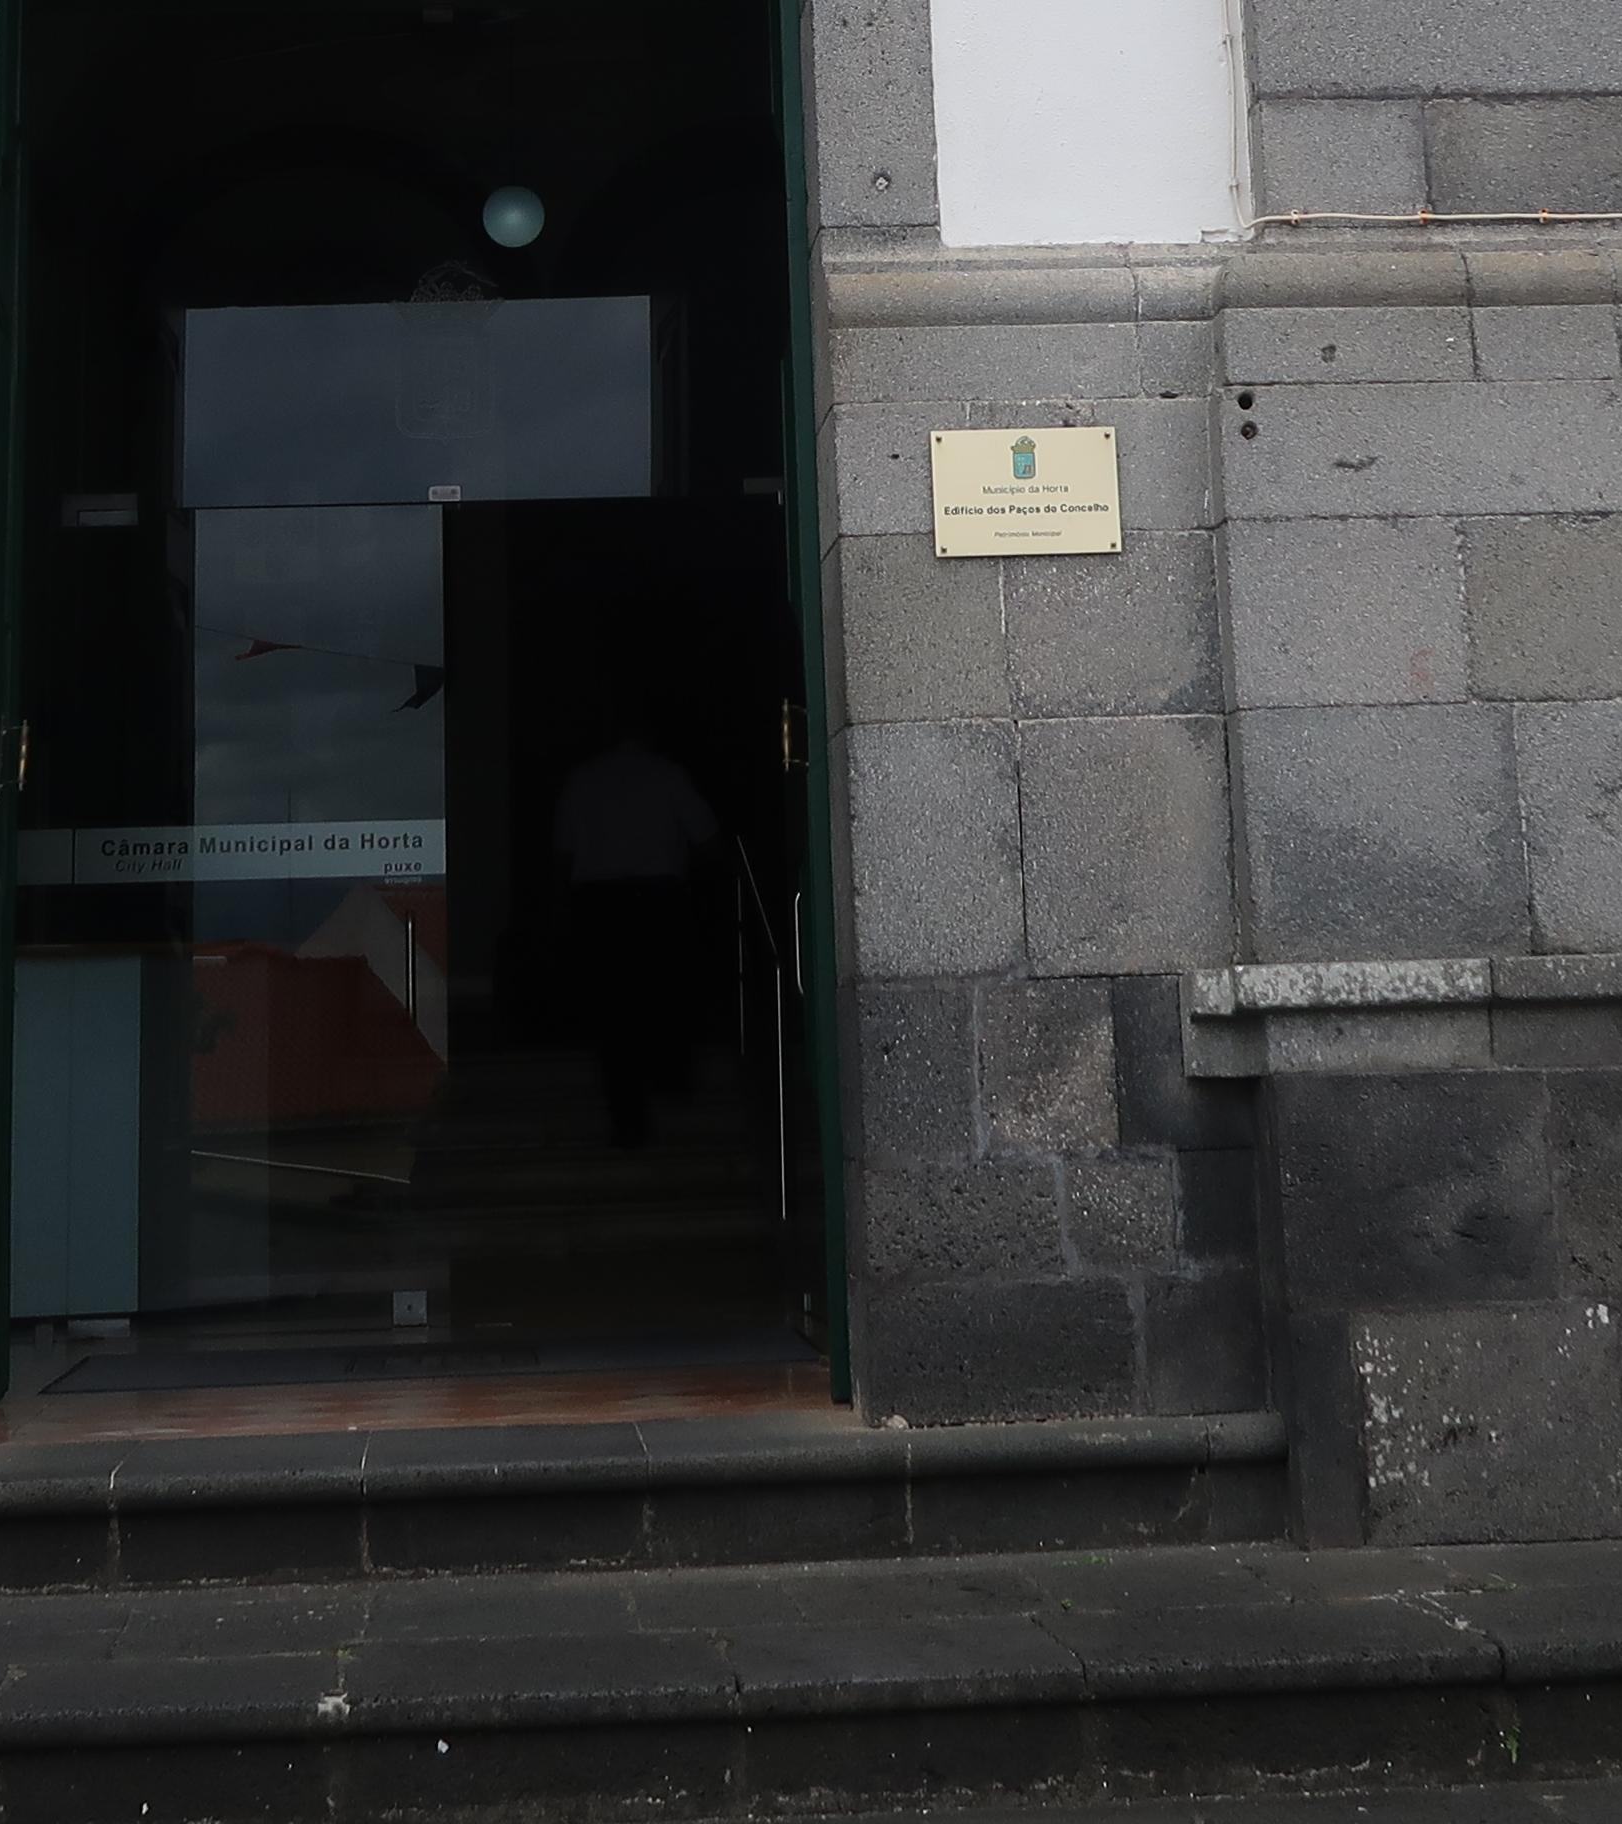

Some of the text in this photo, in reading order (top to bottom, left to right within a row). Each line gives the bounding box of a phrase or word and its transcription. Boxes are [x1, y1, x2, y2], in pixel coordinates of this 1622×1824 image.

[1028, 485, 1040, 494] da
[1042, 484, 1069, 494] Horta
[987, 505, 1006, 515] dos
[1009, 504, 1041, 516] Paços
[1060, 503, 1109, 513] Concelho
[101, 832, 424, 858] Câmara Municipal da Horta
[115, 858, 182, 874] City Hall
